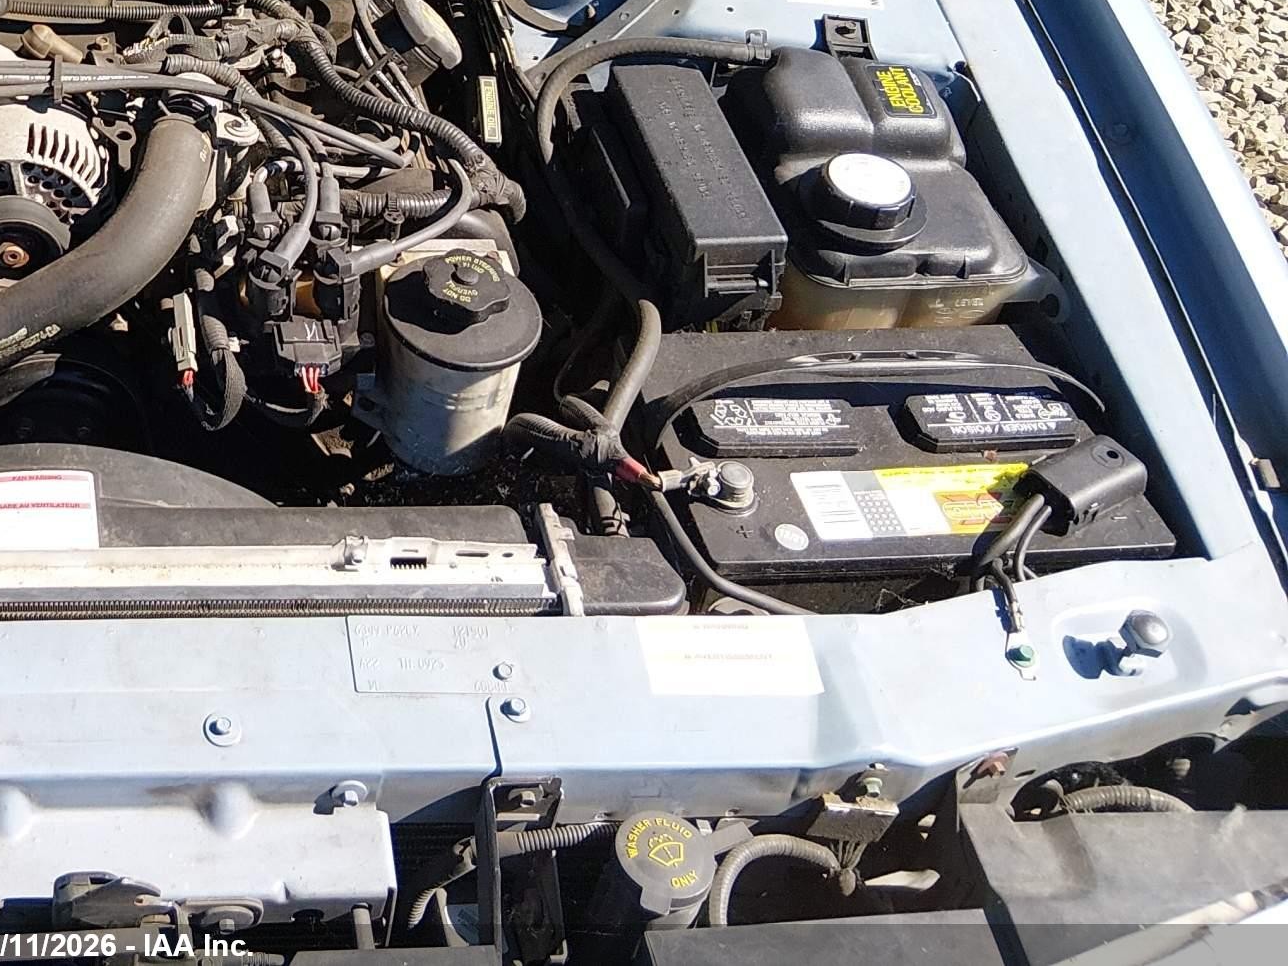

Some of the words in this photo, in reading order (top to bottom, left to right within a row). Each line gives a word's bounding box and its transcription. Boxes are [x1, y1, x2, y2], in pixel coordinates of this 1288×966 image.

[876, 70, 906, 107] ENGINE
[888, 66, 925, 113] COOLANT
[484, 87, 495, 117] ENGINE
[487, 119, 496, 132] OIL
[444, 255, 472, 264] POWER
[473, 258, 500, 282] STEERING
[442, 287, 459, 299] NOT
[459, 294, 472, 303] DO
[950, 424, 993, 434] POISON
[1001, 422, 1046, 432] DANGER
[626, 819, 650, 858] WASHER
[655, 818, 693, 838] FLUID
[671, 870, 699, 889] ONLY
